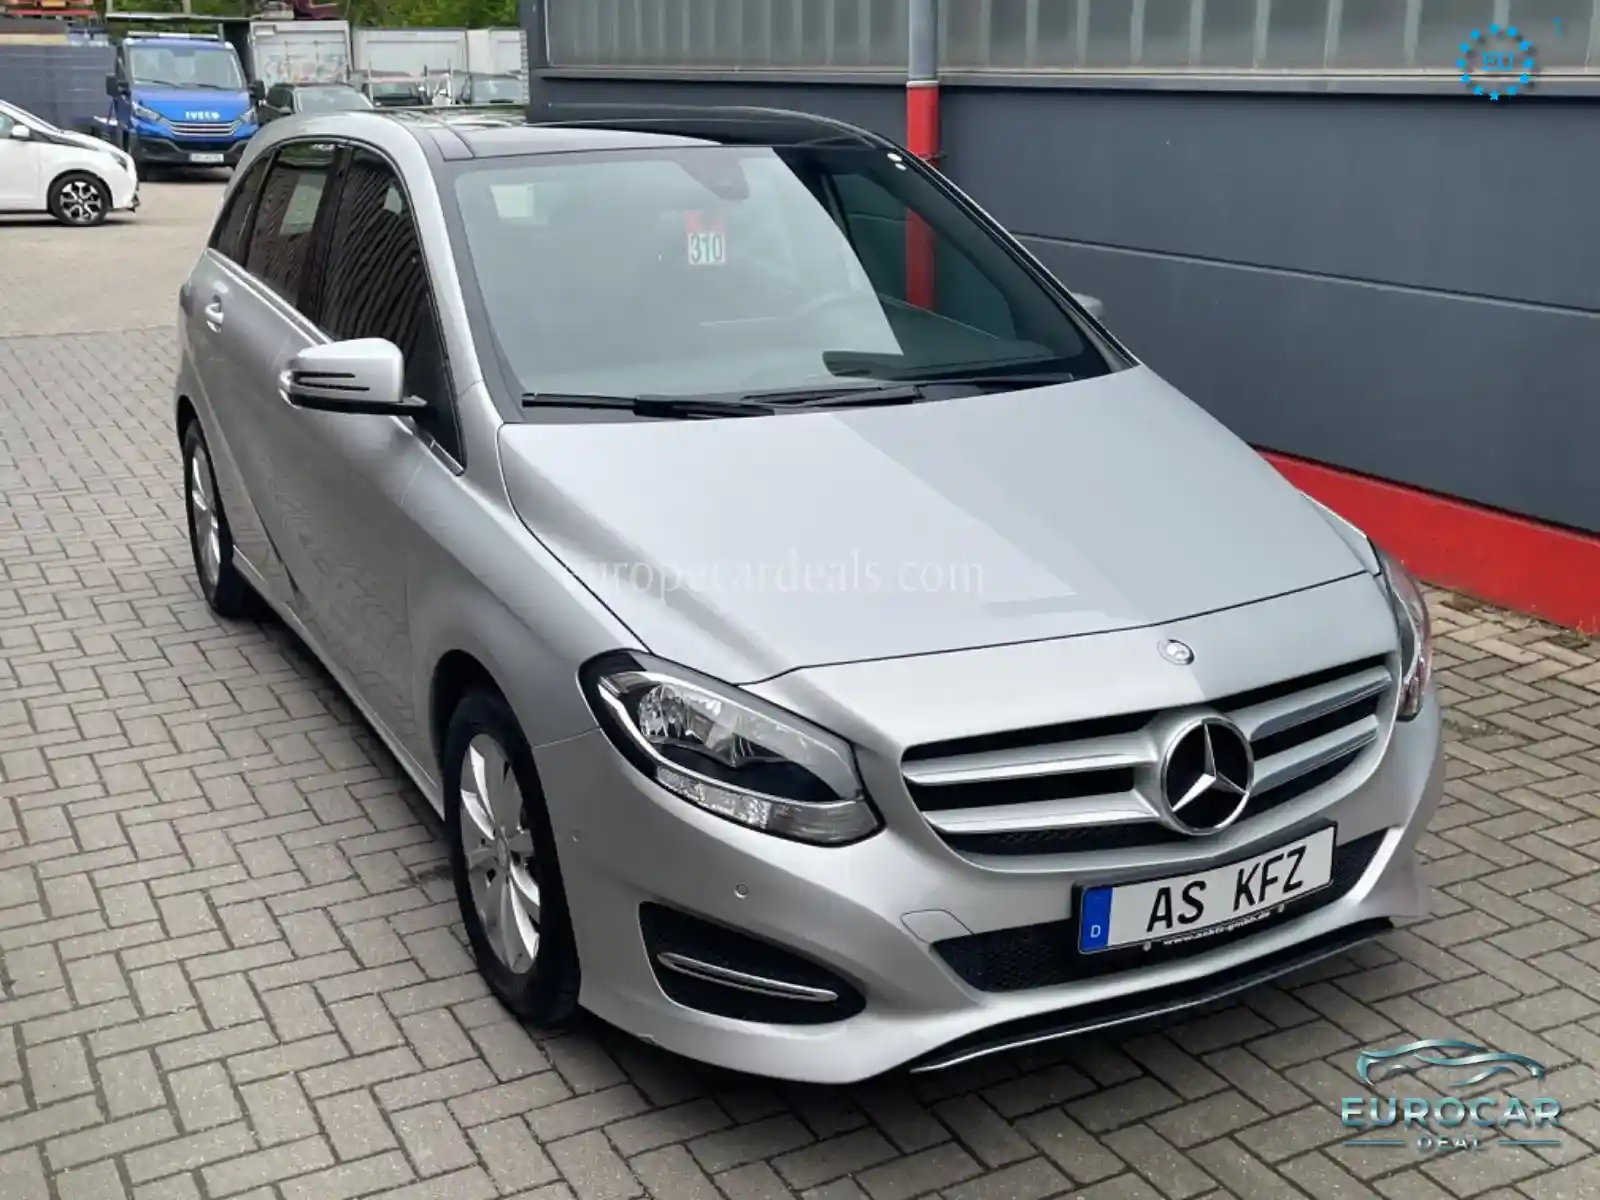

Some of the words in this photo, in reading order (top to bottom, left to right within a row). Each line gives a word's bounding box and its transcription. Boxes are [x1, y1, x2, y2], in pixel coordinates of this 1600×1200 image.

[185, 111, 221, 120] IVECO
[690, 233, 724, 263] 310
[1146, 880, 1207, 933] AS
[1233, 845, 1308, 912] KFZ
[1090, 924, 1101, 938] D
